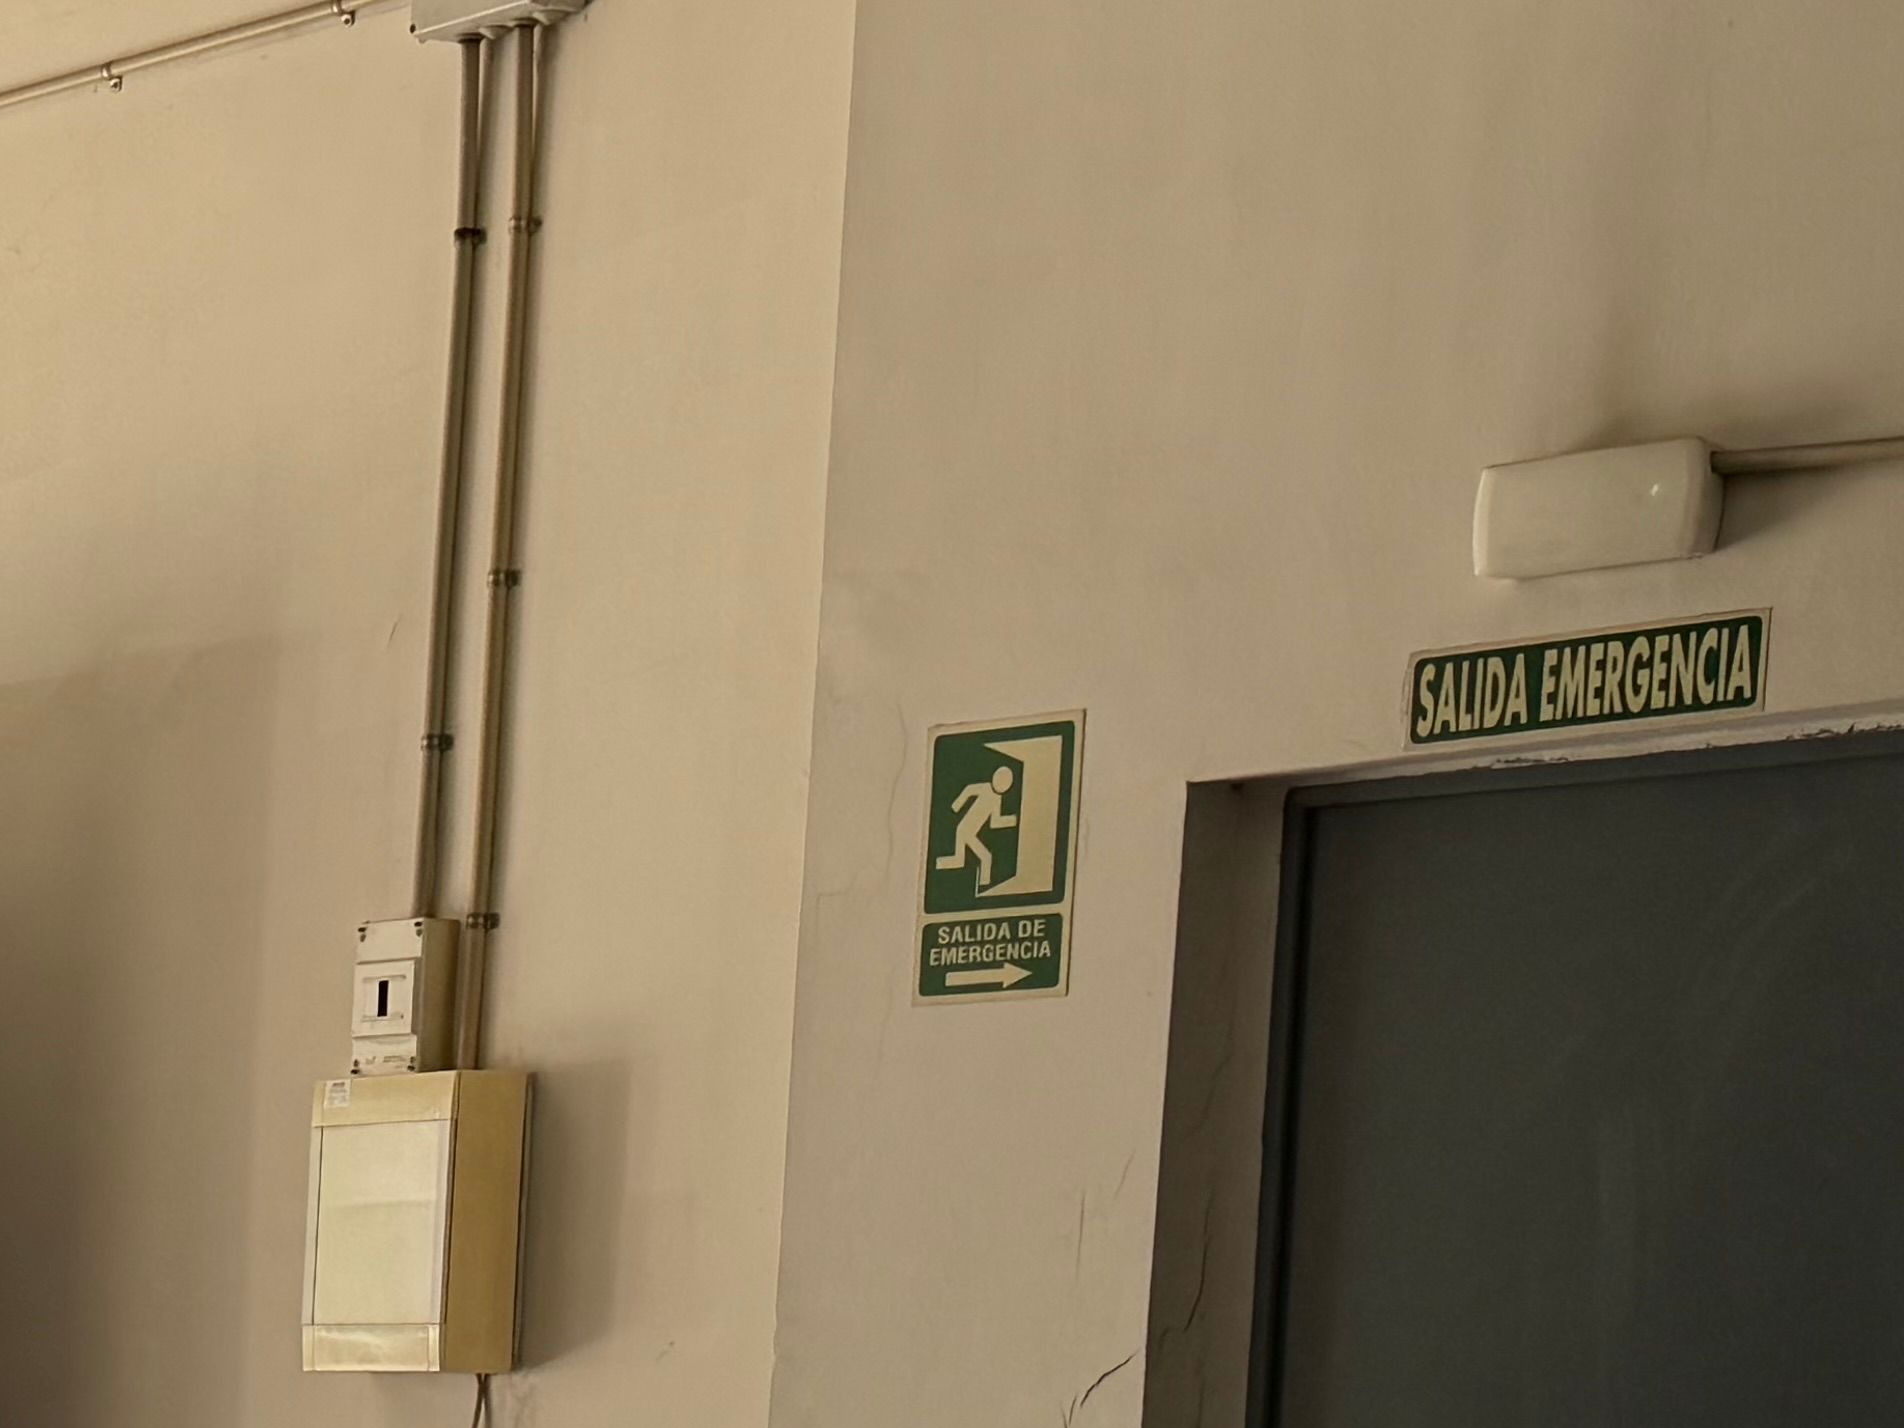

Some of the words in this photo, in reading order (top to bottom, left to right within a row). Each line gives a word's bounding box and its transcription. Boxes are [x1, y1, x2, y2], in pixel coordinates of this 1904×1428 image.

[1416, 652, 1528, 738] SALIDA
[1539, 624, 1753, 722] EMERGENCIA
[937, 922, 1011, 944] SALIDA
[1018, 919, 1046, 938] DE
[929, 940, 1051, 966] EMERGENCIA
